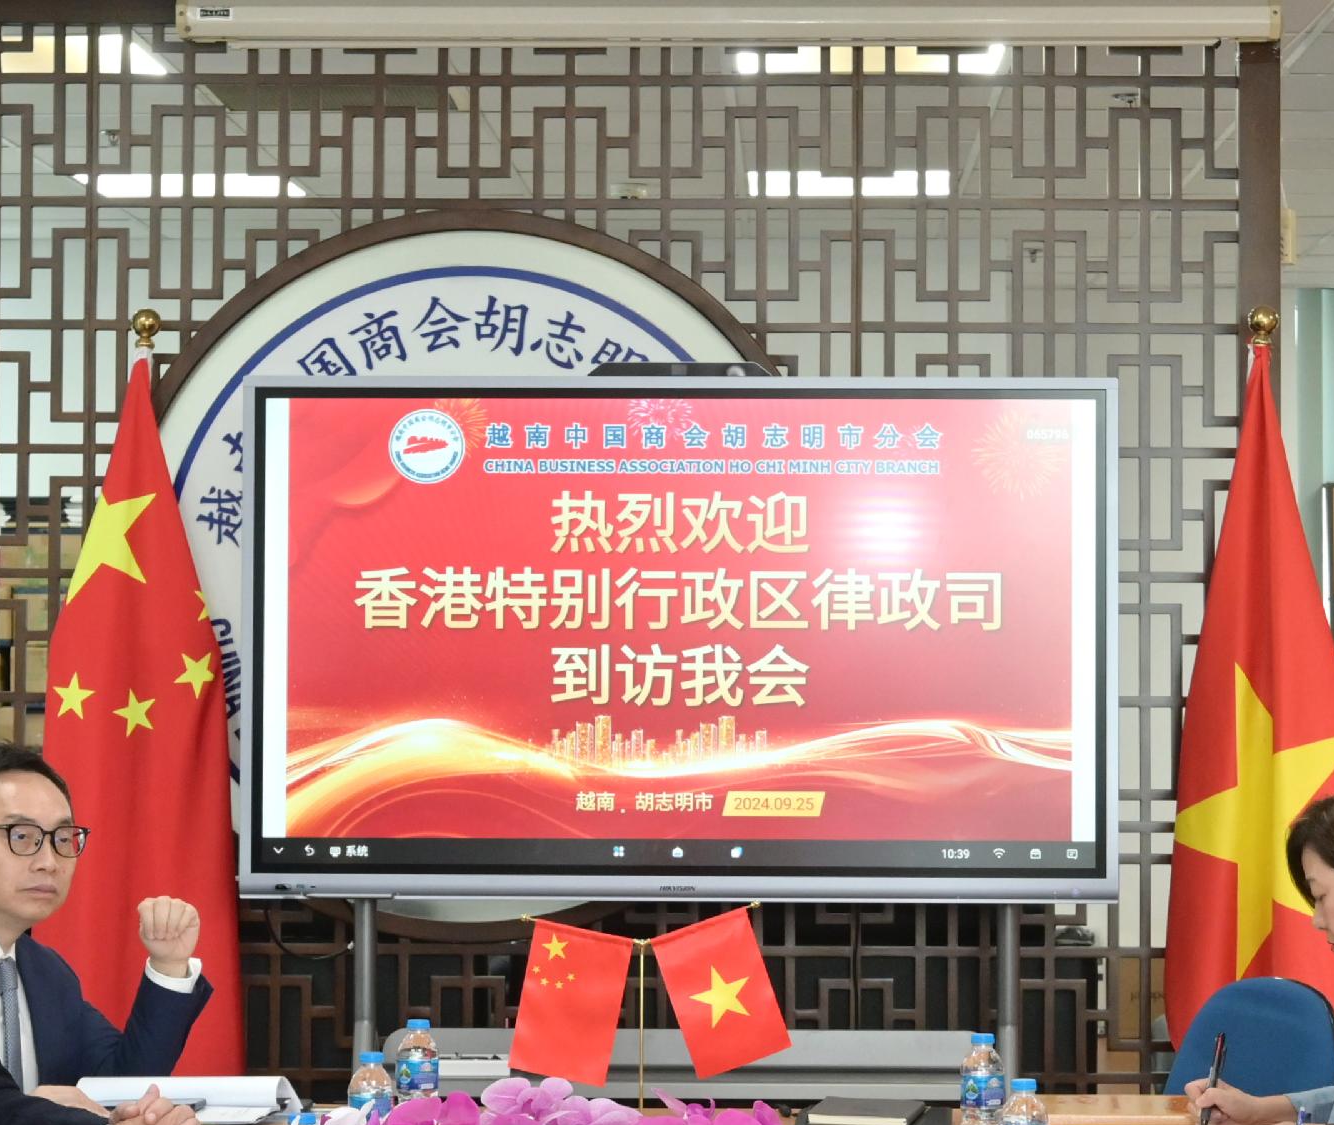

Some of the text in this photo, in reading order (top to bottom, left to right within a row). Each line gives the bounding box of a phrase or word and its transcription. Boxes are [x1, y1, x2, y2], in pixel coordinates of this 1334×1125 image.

[486, 422, 942, 449] 越南中国商会胡志明市分会
[484, 459, 940, 475] CHINA BUSINESS ASSOCIATION HO CHI MINH CITY BRANCH
[549, 489, 811, 555] 热烈欢迎
[353, 566, 1003, 632] 香港特别行政区律政司
[549, 643, 812, 708] 到访我会
[733, 796, 816, 812] 2024.09.25
[345, 844, 369, 858] 系统
[941, 847, 971, 861] 10:39
